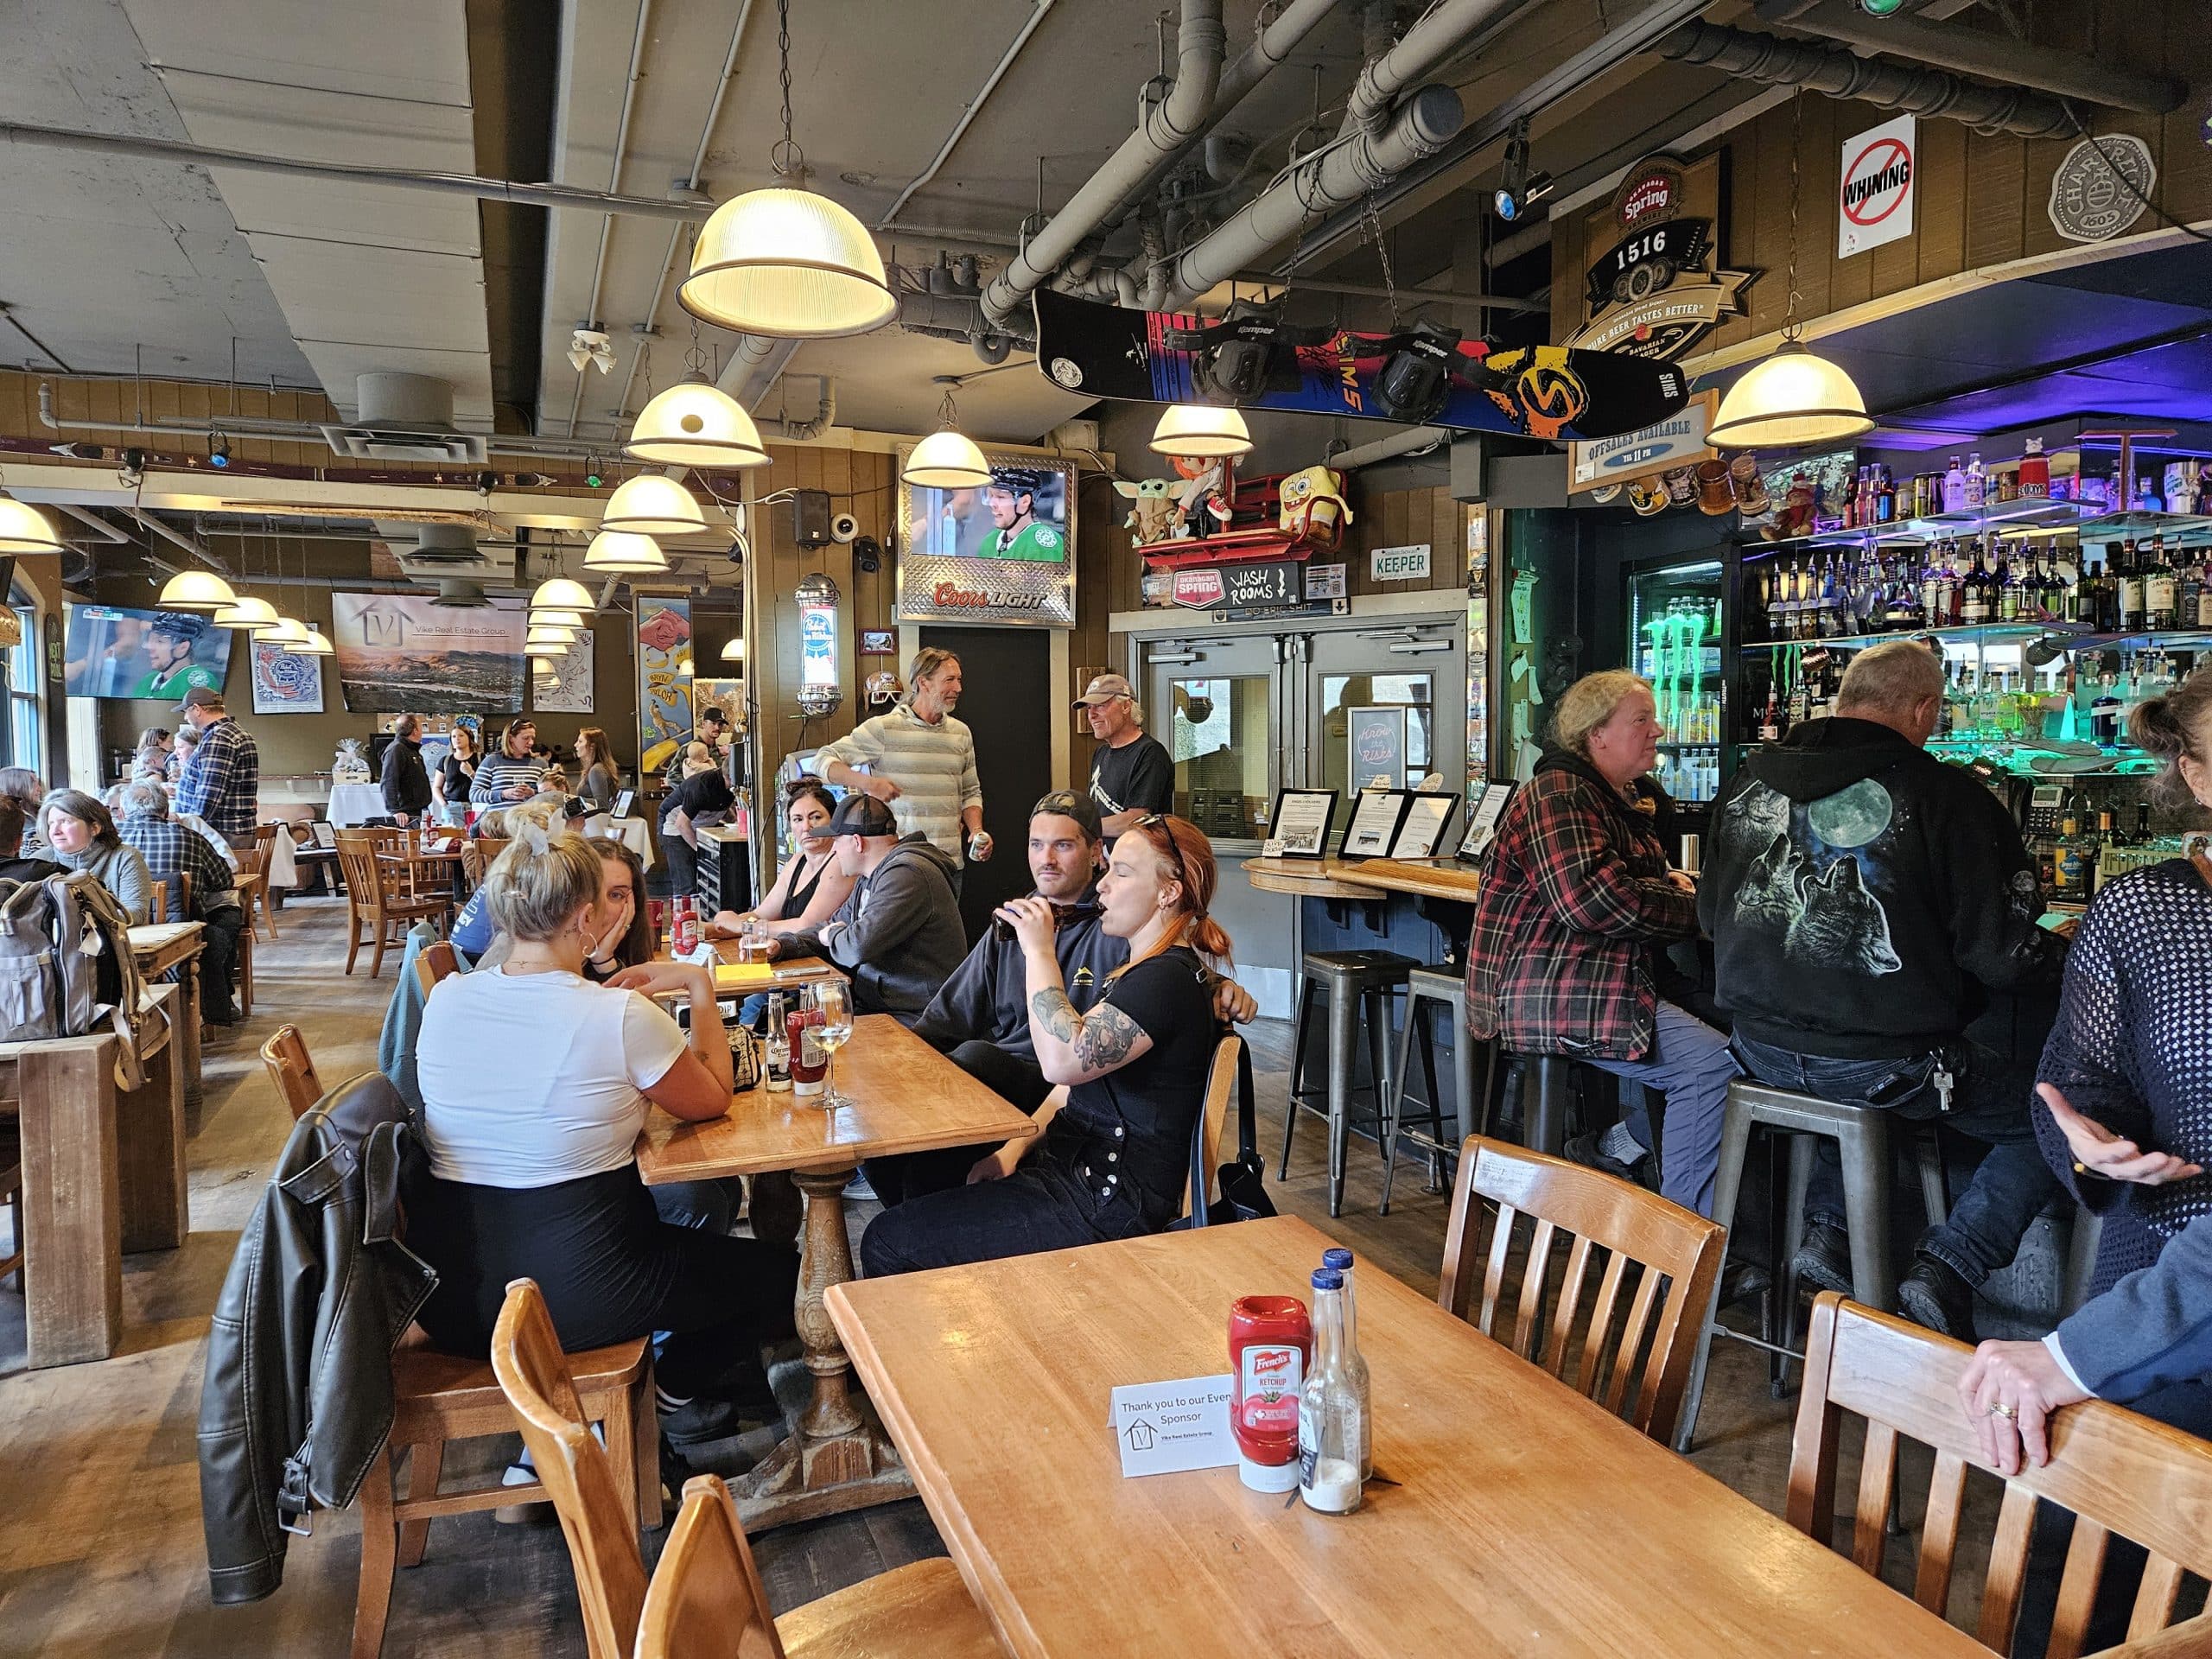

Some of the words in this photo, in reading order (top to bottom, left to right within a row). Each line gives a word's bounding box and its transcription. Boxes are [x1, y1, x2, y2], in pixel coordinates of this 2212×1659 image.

[1843, 160, 1910, 207] WHINING
[1624, 189, 1669, 219] Spring
[2082, 212, 2116, 226] 1605
[1618, 230, 1667, 270] 1516
[1236, 324, 1275, 336] Kemper
[1609, 320, 1630, 339] BEER
[1632, 308, 1662, 327] TASTES
[1412, 339, 1449, 359] Kemper
[1637, 346, 1660, 359] AGER
[1658, 372, 1680, 399] SIMS
[1589, 434, 1634, 461] OFFSALES
[1637, 420, 1691, 442] AVAILABLE
[1633, 449, 1642, 461] 11
[1642, 448, 1652, 458] PM
[1376, 555, 1425, 574] KEEPER
[1230, 569, 1268, 588] WASH
[933, 581, 988, 607] Coors
[988, 592, 1047, 609] LIGHT
[1230, 584, 1274, 605] ROOMS
[415, 625, 433, 634] Vike
[435, 626, 454, 634] Real
[454, 626, 479, 635] Estate
[480, 627, 506, 636] Group
[1360, 726, 1393, 741] Know
[1362, 747, 1393, 762] Risks
[1255, 1353, 1288, 1370] French's
[1259, 1378, 1287, 1387] KETCHUP
[1121, 1401, 1154, 1414] Thank
[1155, 1400, 1174, 1412] you
[1175, 1397, 1186, 1407] to
[1188, 1396, 1205, 1406] our
[1160, 1412, 1203, 1427] Sponsor
